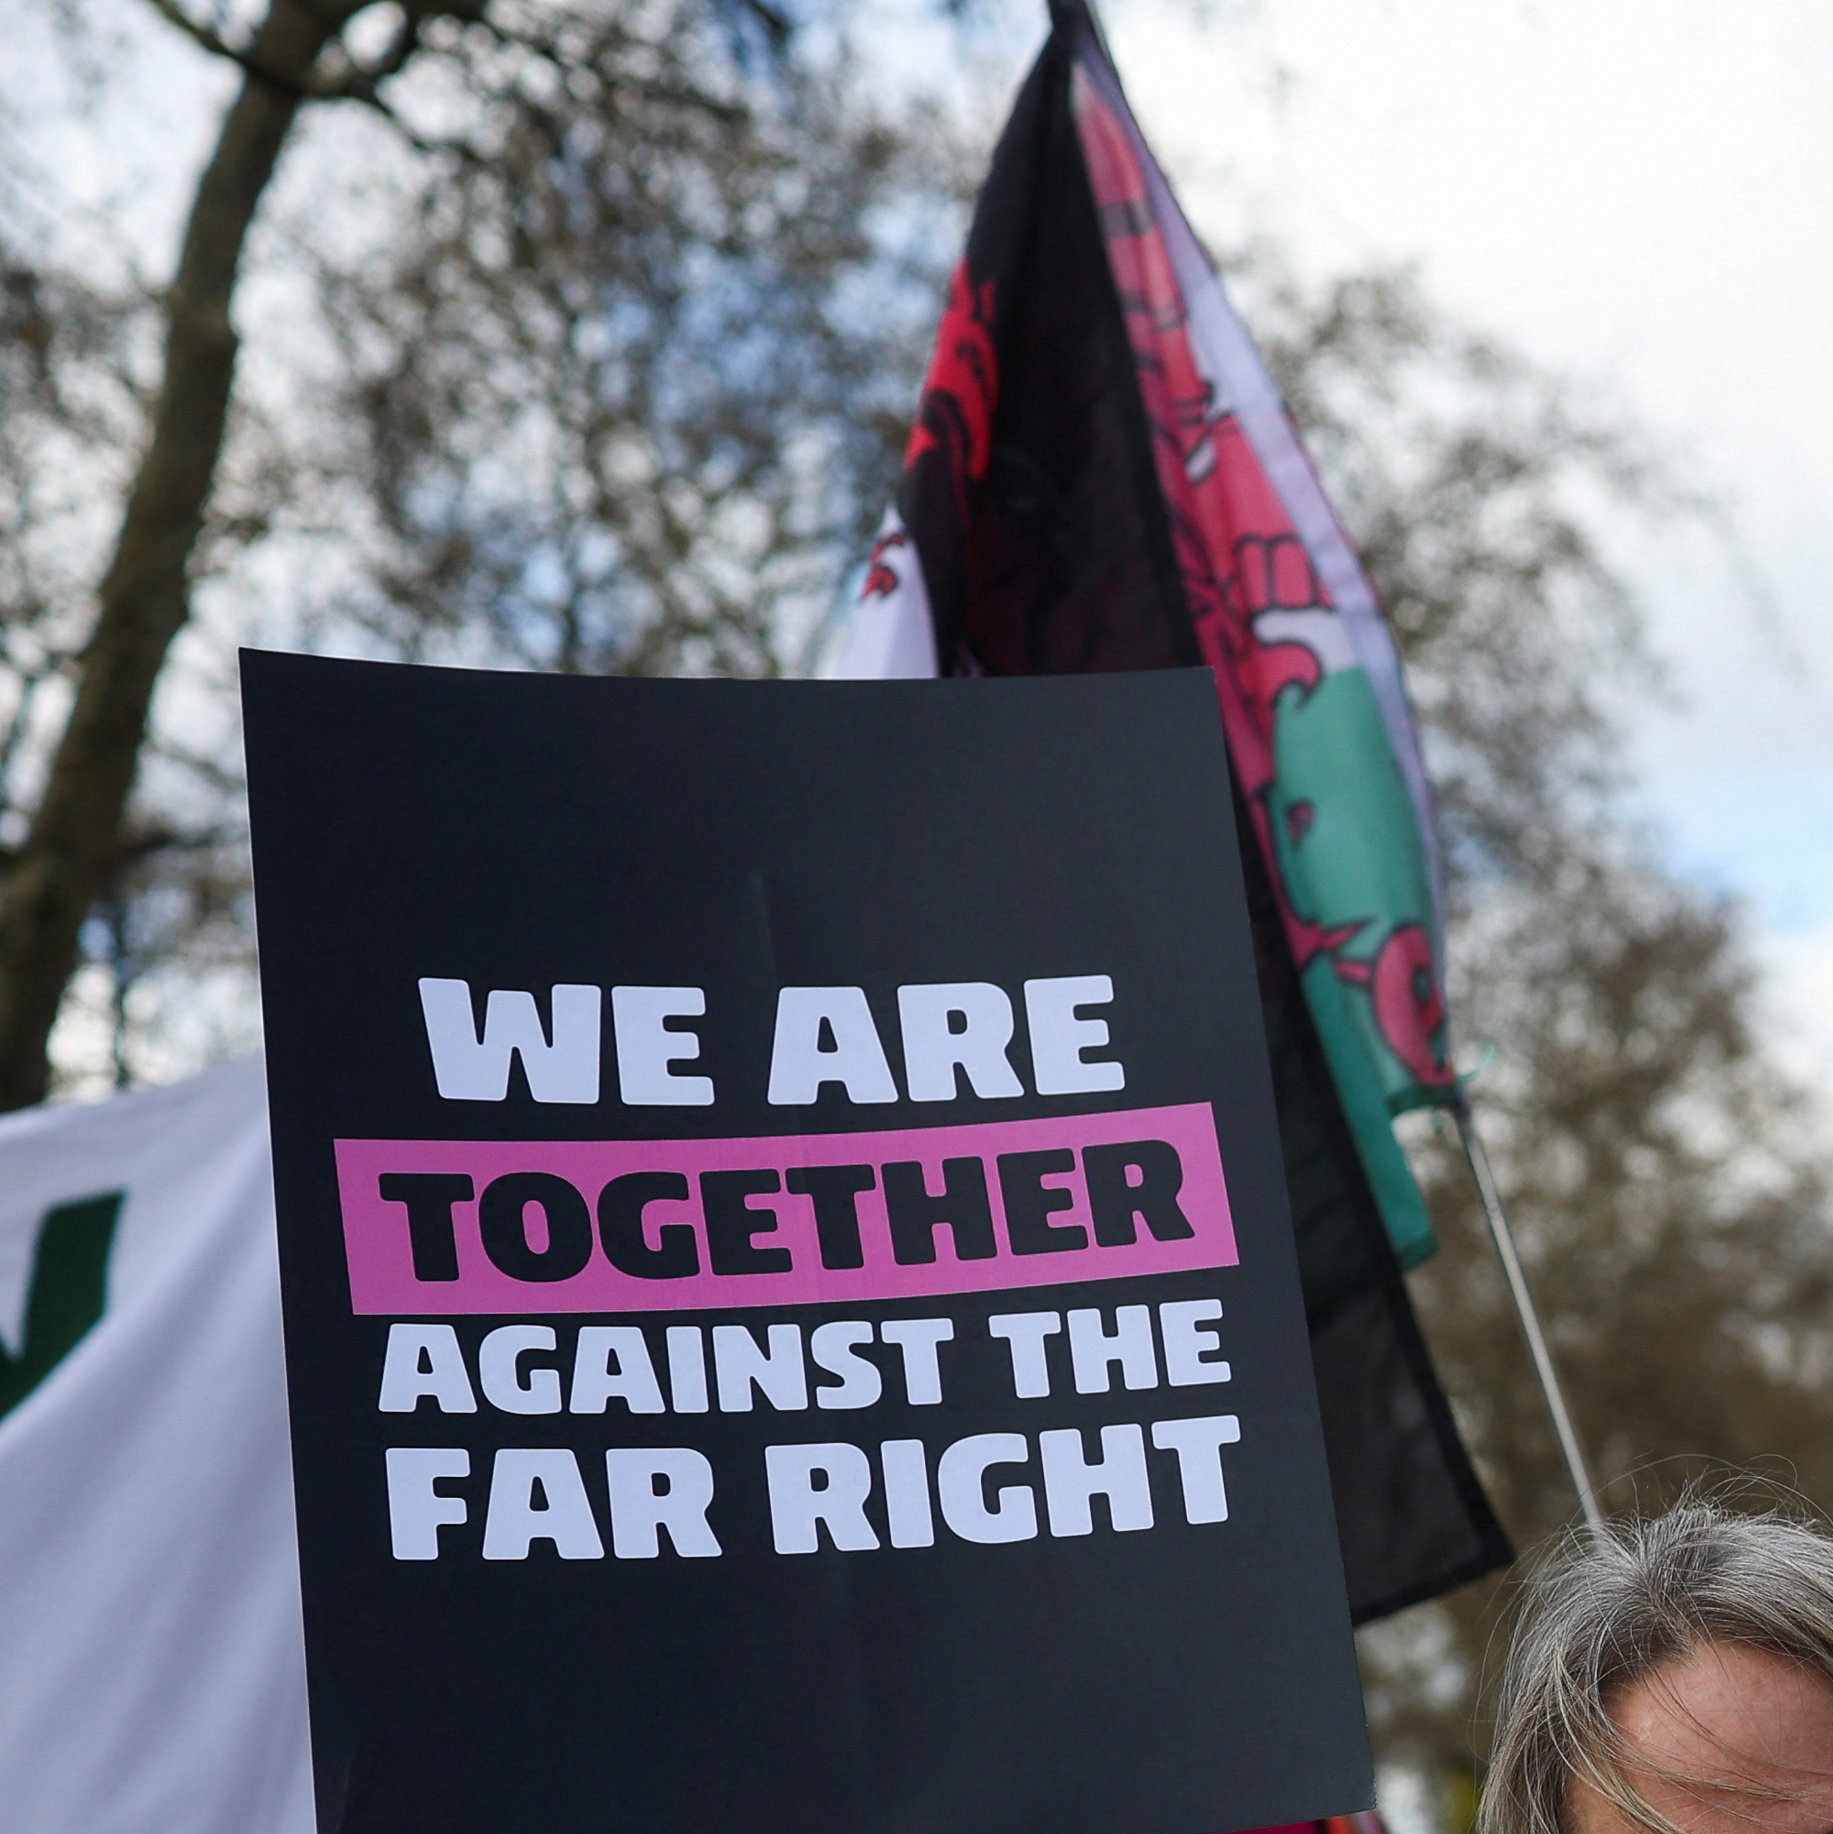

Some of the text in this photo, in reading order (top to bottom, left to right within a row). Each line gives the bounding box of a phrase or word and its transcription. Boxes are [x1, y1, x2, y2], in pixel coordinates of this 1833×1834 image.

[418, 974, 1125, 1107] WE ARE
[377, 1139, 1196, 1283] TOGETHER
[378, 1298, 1232, 1415] AGAINST THE
[385, 1414, 1241, 1560] FAR RIGHT
